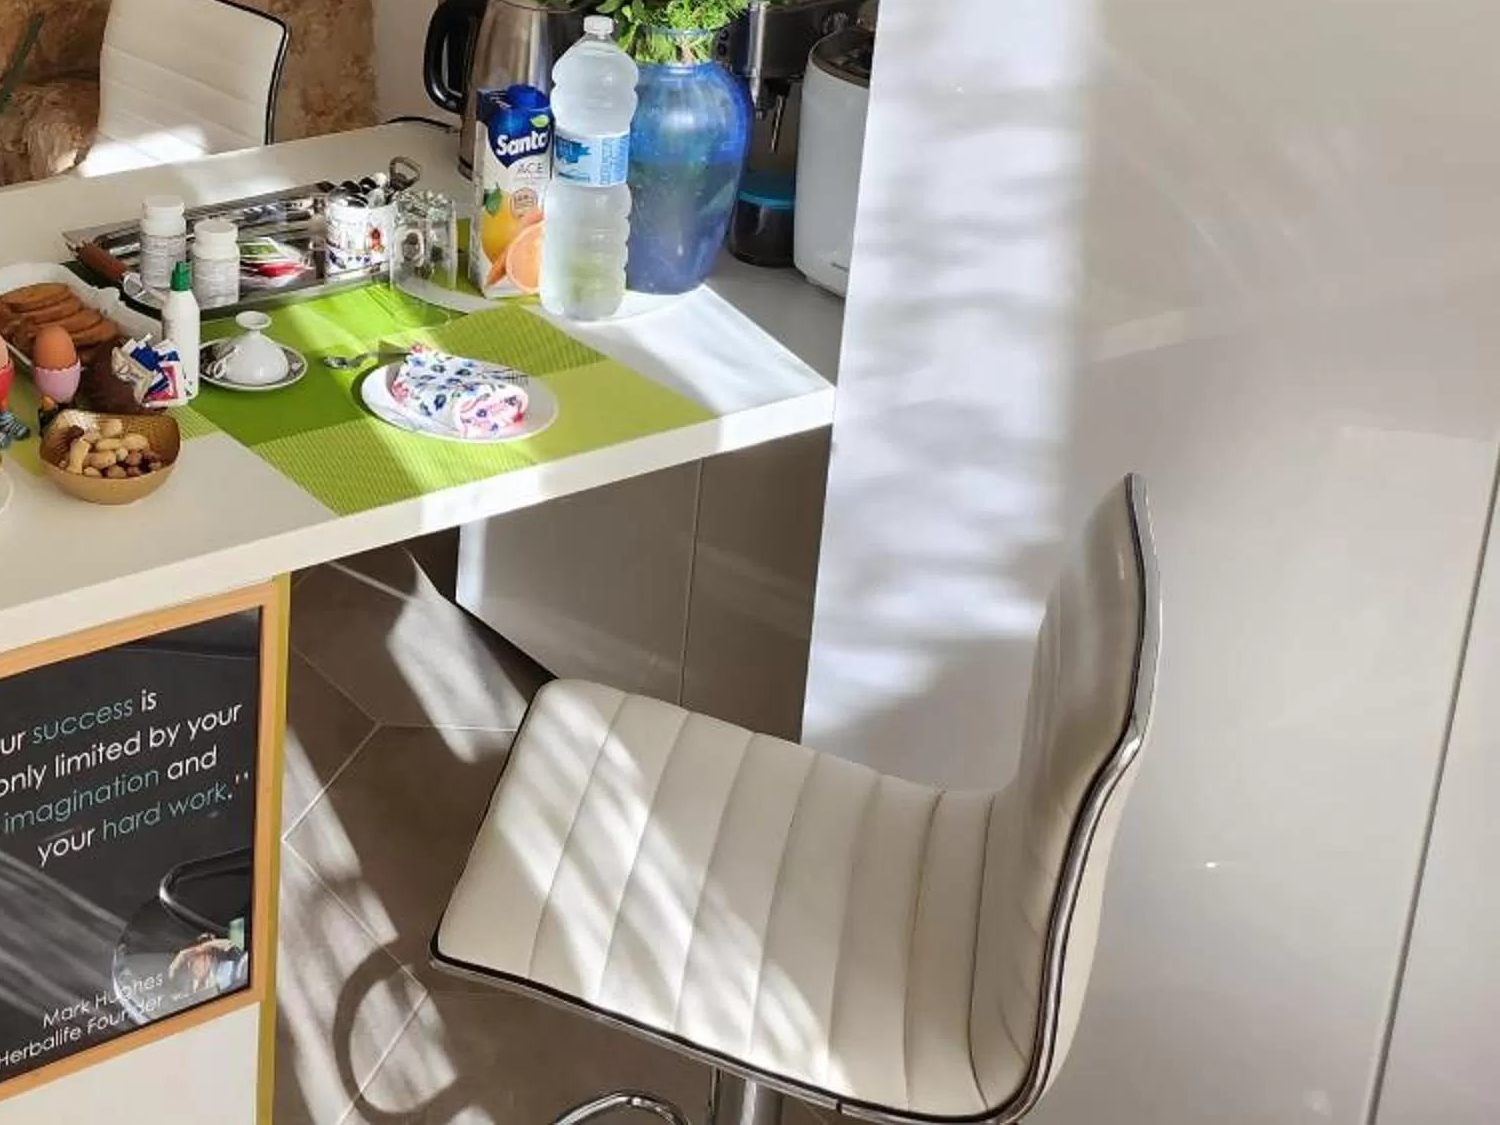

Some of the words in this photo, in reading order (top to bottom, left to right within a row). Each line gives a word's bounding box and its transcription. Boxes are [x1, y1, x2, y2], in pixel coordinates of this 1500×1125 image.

[32, 698, 133, 745] success
[141, 688, 158, 713] is
[54, 730, 142, 779] limited
[149, 719, 181, 749] by
[187, 703, 242, 741] your
[3, 769, 160, 835] imagination
[167, 745, 218, 780] and
[37, 826, 96, 867] your
[102, 803, 161, 840] hard
[42, 1000, 91, 1029] Mark
